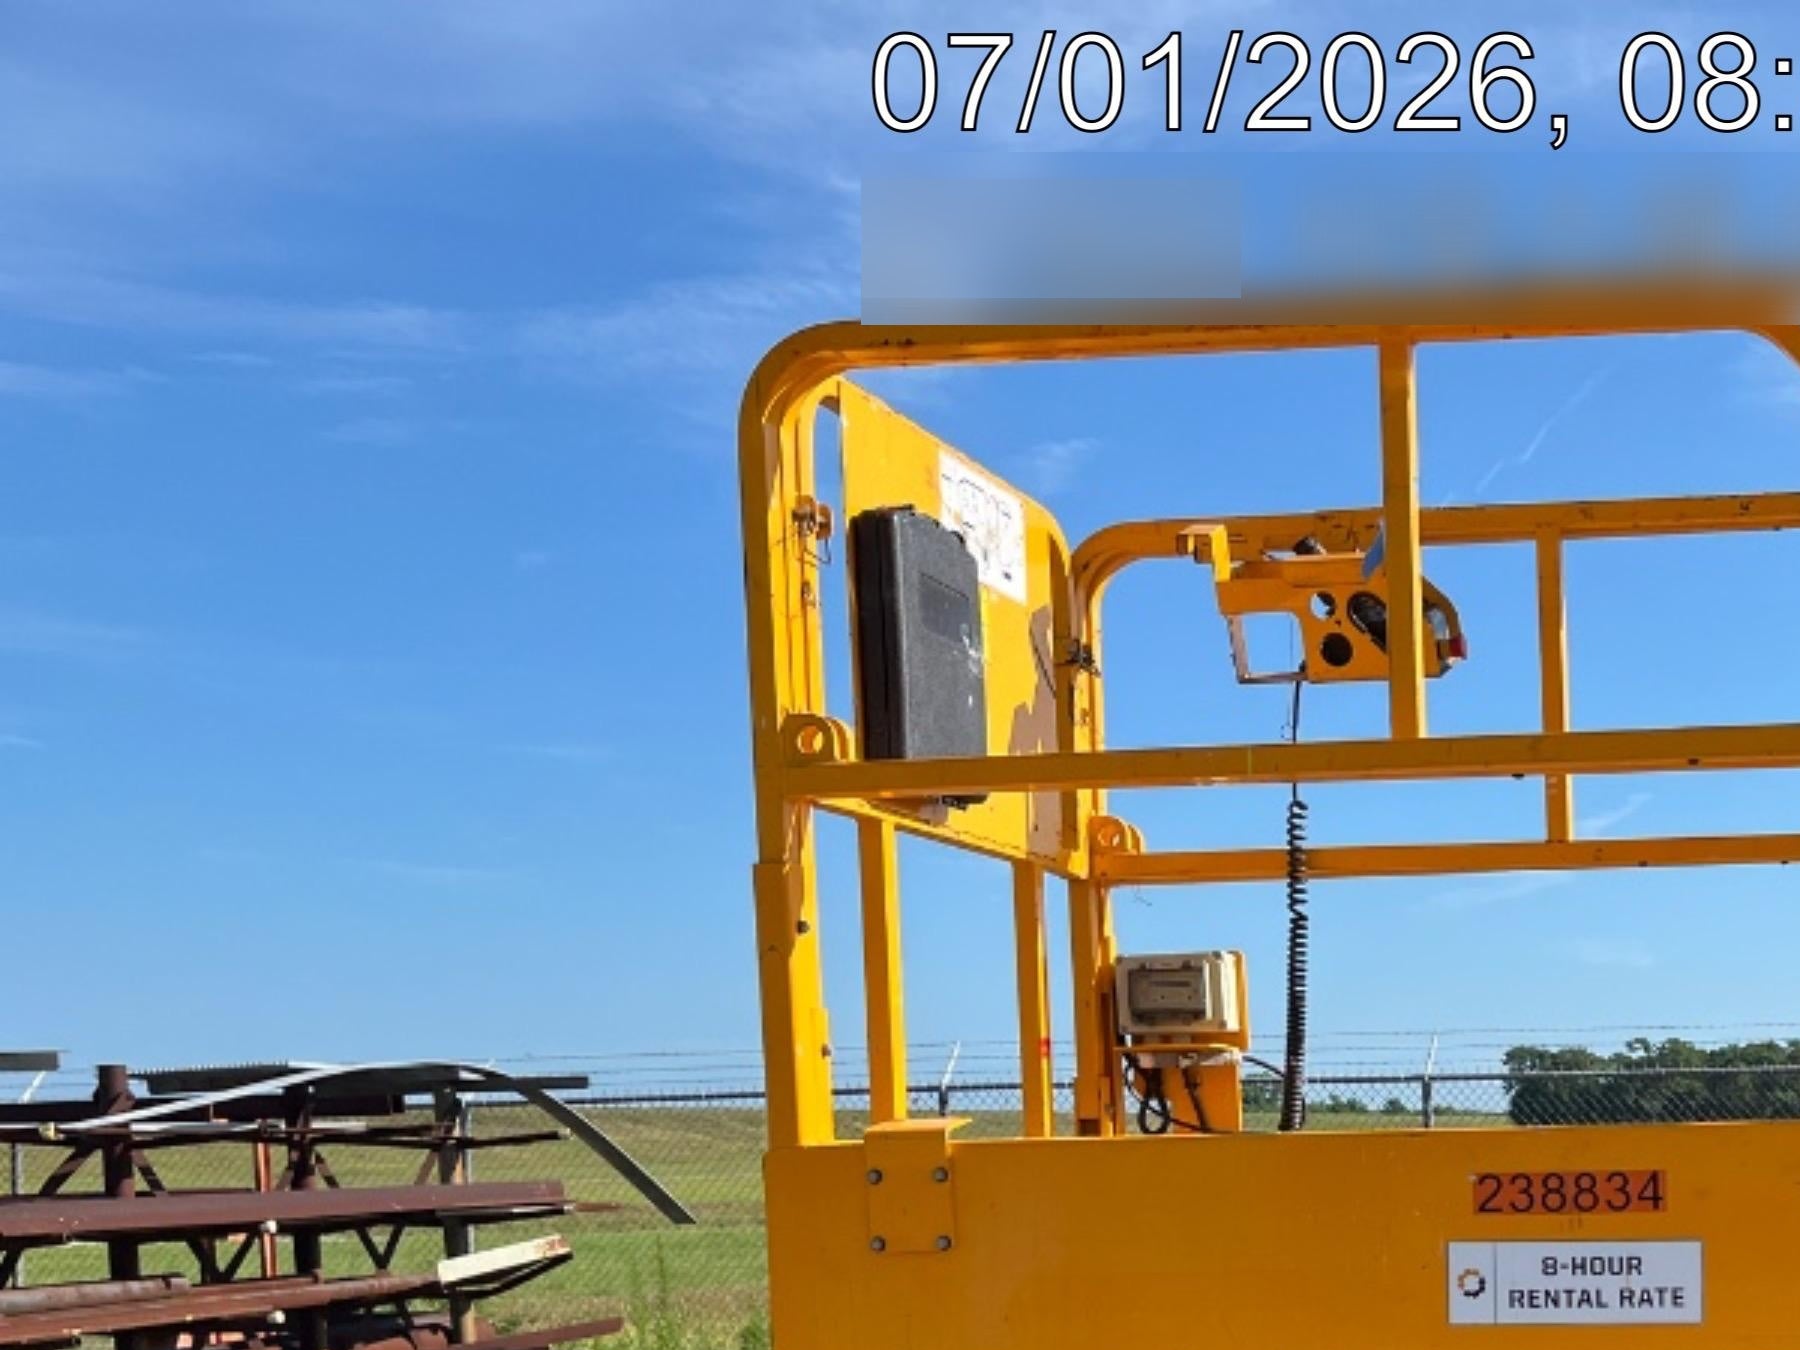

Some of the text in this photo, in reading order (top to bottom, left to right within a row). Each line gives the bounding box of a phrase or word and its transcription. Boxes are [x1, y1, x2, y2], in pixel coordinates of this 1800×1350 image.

[1476, 1170, 1664, 1213] 238834
[1540, 1255, 1643, 1277] 8-HOUR
[1508, 1287, 1685, 1309] RENTAL RATE
